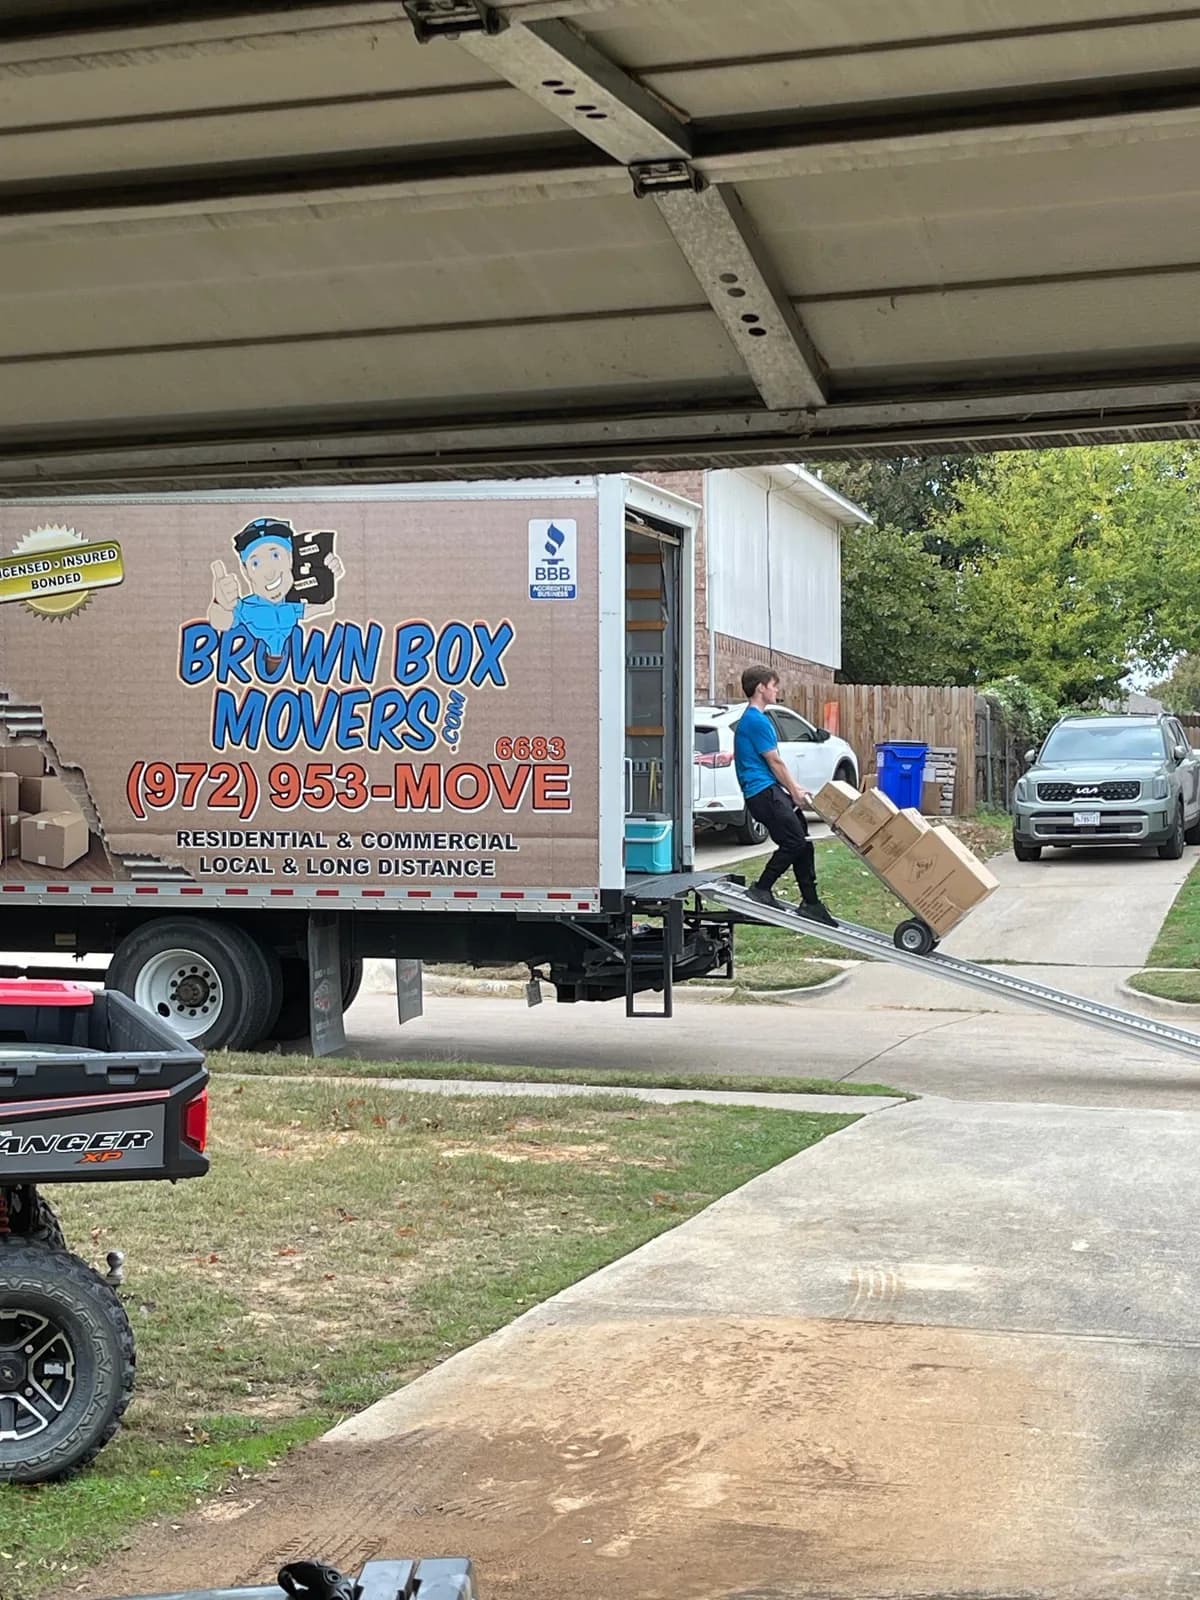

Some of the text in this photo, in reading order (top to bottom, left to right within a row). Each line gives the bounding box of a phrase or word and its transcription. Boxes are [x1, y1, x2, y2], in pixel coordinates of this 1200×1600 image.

[0, 549, 116, 579] ICENSED INSURED
[535, 567, 570, 580] BBB
[31, 572, 81, 590] BONDED
[180, 621, 514, 688] BROWN BOX
[212, 688, 440, 751] MOVERS
[495, 736, 566, 760] 6683
[126, 761, 572, 820] (972) 953-MOVE
[177, 831, 518, 850] RESIDENTIAL & COMMERCIAL
[200, 857, 496, 876] LOCAL & LONG DISTANCE
[0, 1130, 153, 1155] ANGER
